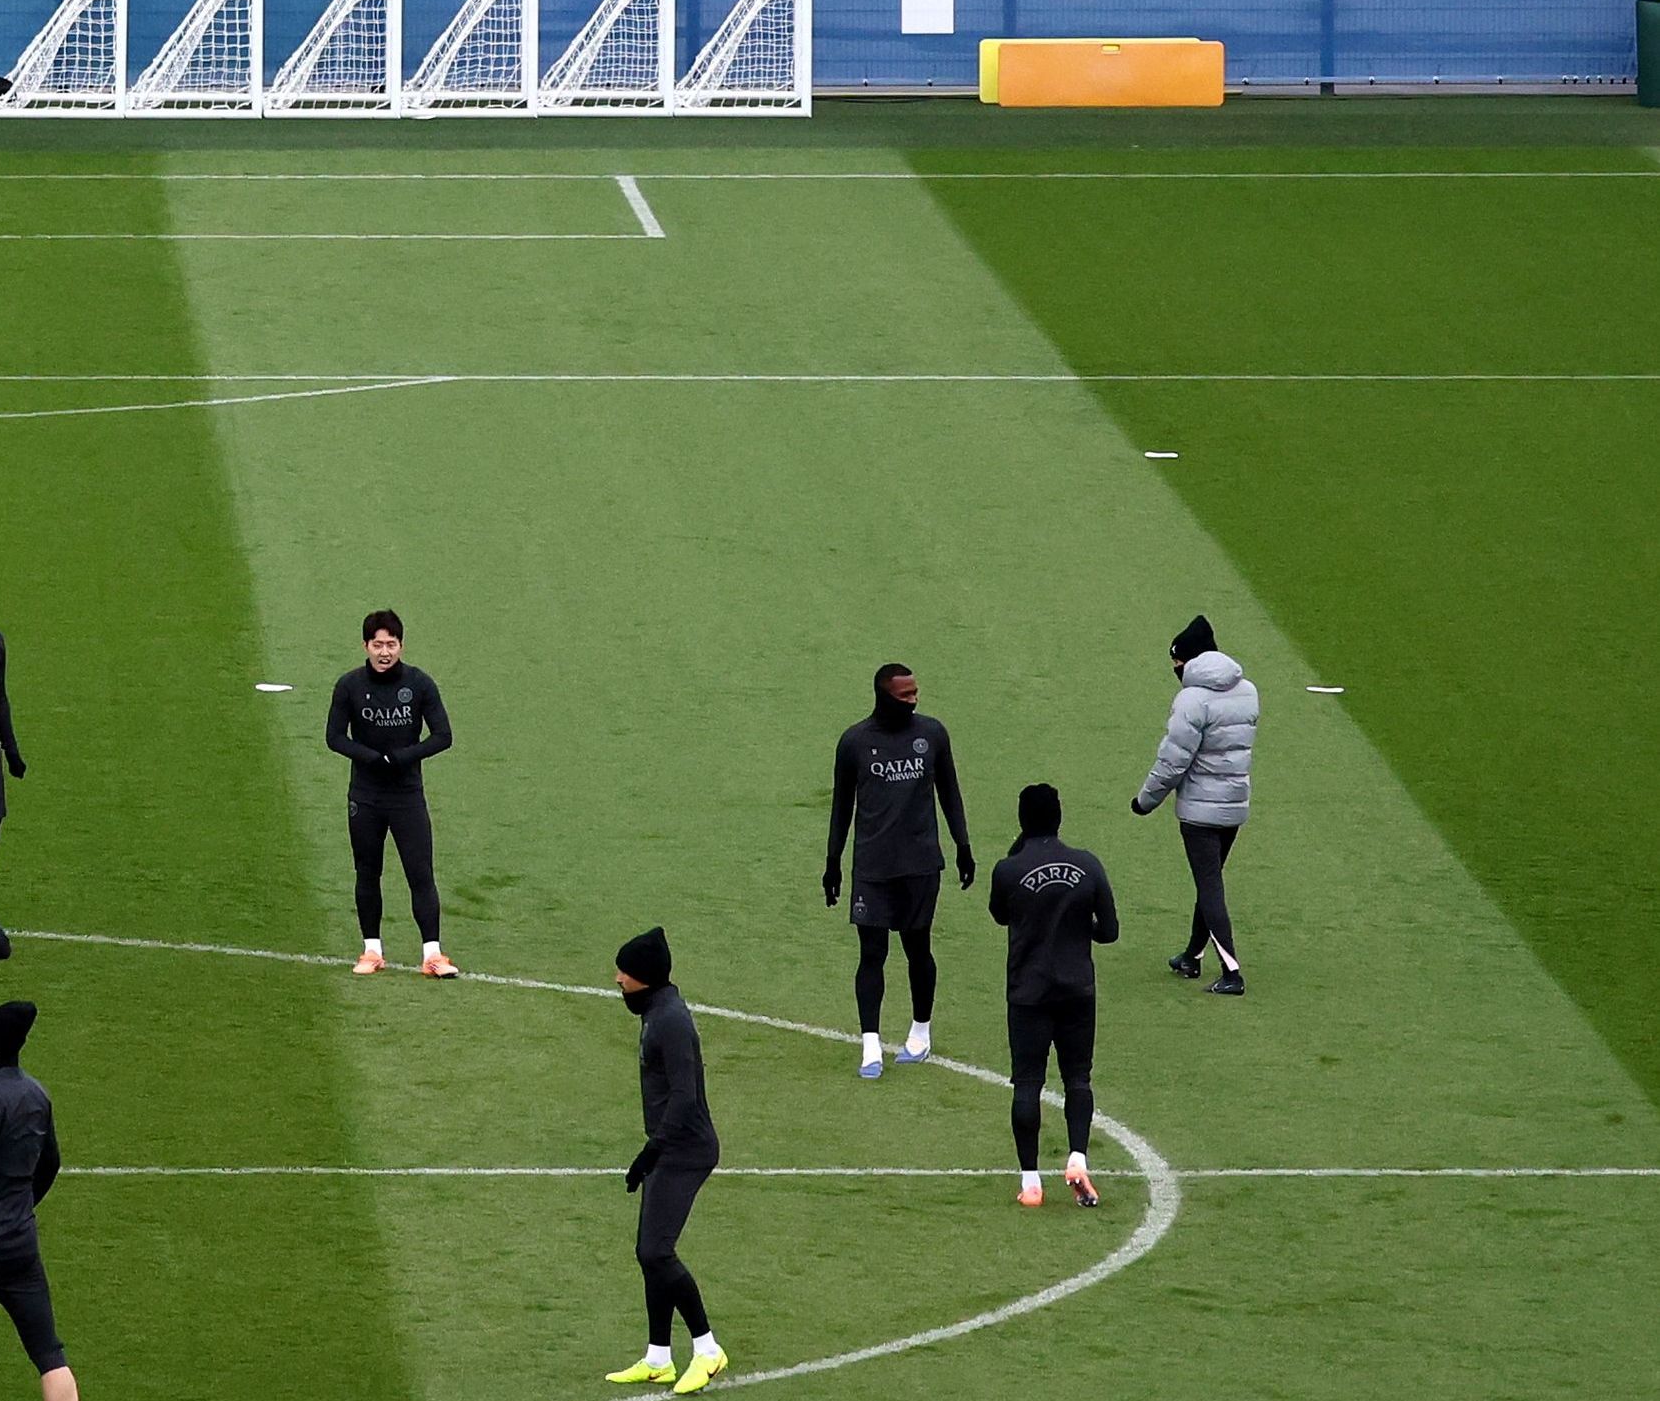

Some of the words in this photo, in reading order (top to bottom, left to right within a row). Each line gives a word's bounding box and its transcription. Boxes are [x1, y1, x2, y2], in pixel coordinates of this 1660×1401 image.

[362, 705, 412, 722] QATAR
[374, 717, 415, 727] AIRWAYS
[870, 756, 925, 778] QATAR
[885, 770, 925, 783] AIRWAYS
[1023, 866, 1084, 892] PARIS
